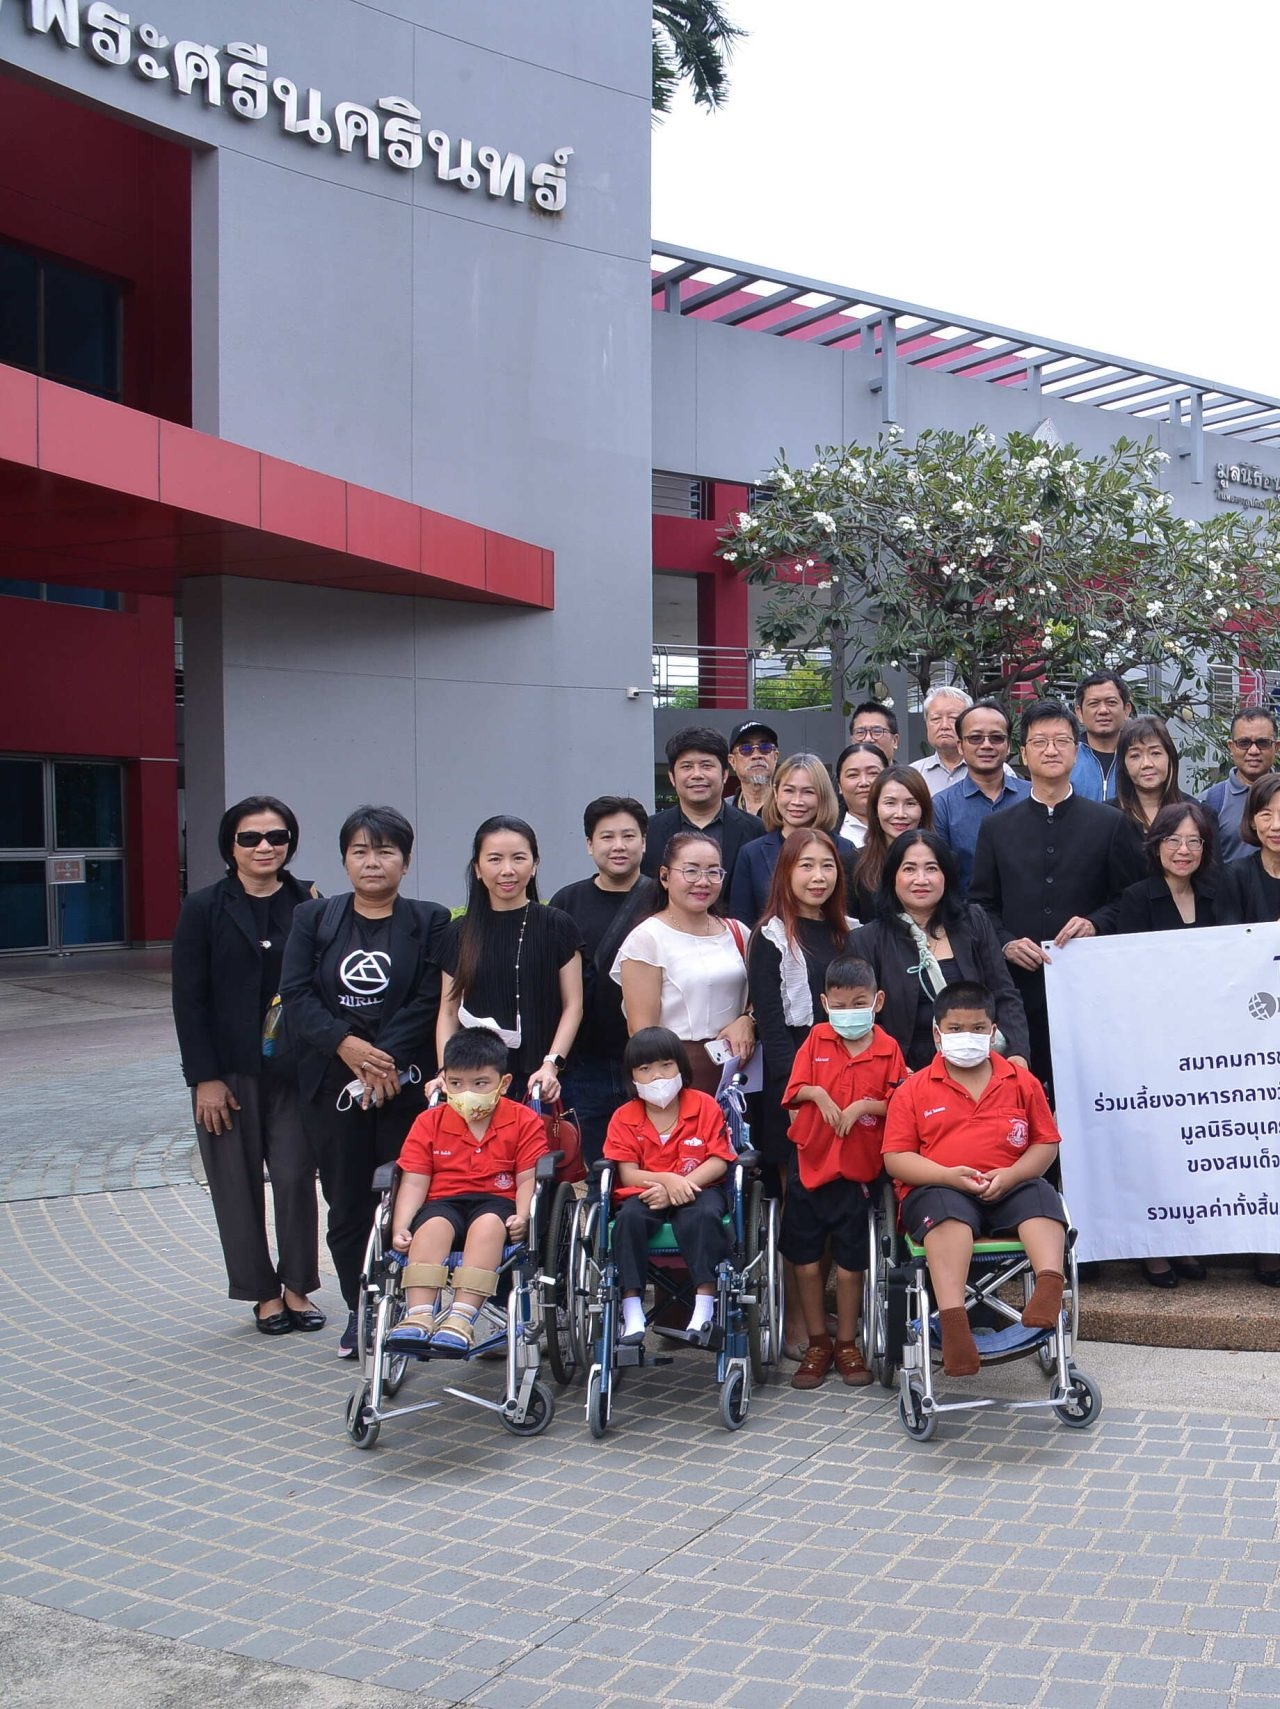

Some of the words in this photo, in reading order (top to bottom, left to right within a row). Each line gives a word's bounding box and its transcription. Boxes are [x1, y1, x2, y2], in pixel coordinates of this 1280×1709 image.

[1147, 1192, 1279, 1224] รวมมูลค่าทั้งสิ้น
